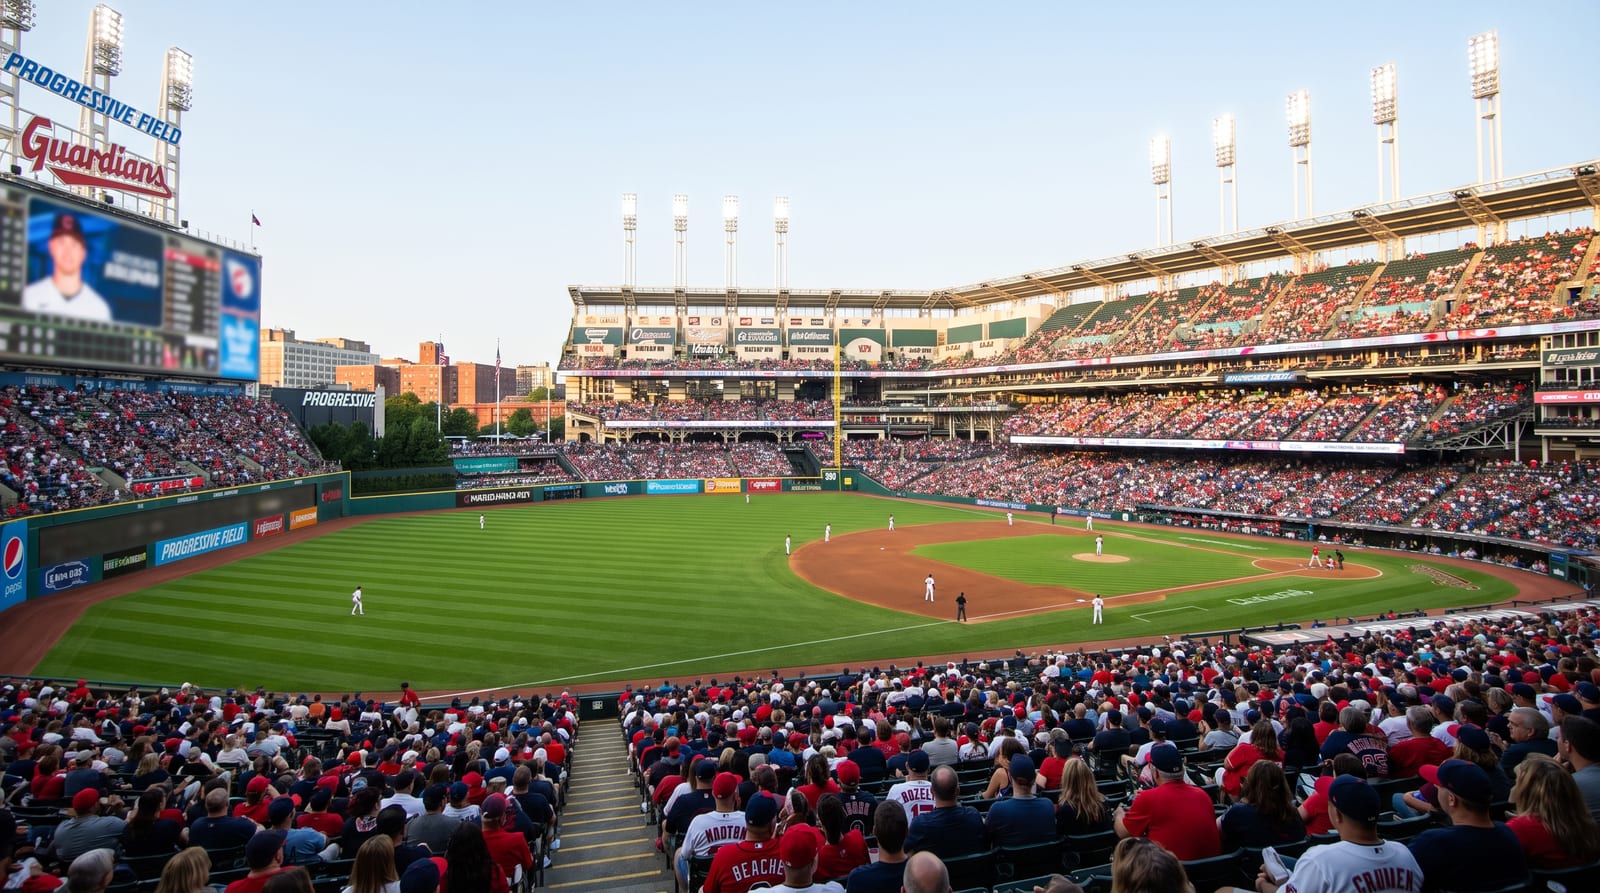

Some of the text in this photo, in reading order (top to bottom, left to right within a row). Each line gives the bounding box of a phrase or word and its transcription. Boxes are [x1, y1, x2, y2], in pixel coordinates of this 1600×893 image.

[4, 52, 182, 145] PROGRESSIVE FIELD
[21, 115, 169, 190] Guardians
[302, 391, 376, 407] PROGRESSIVE
[161, 534, 219, 560] PROGRESSIVE
[221, 526, 244, 545] FIELD
